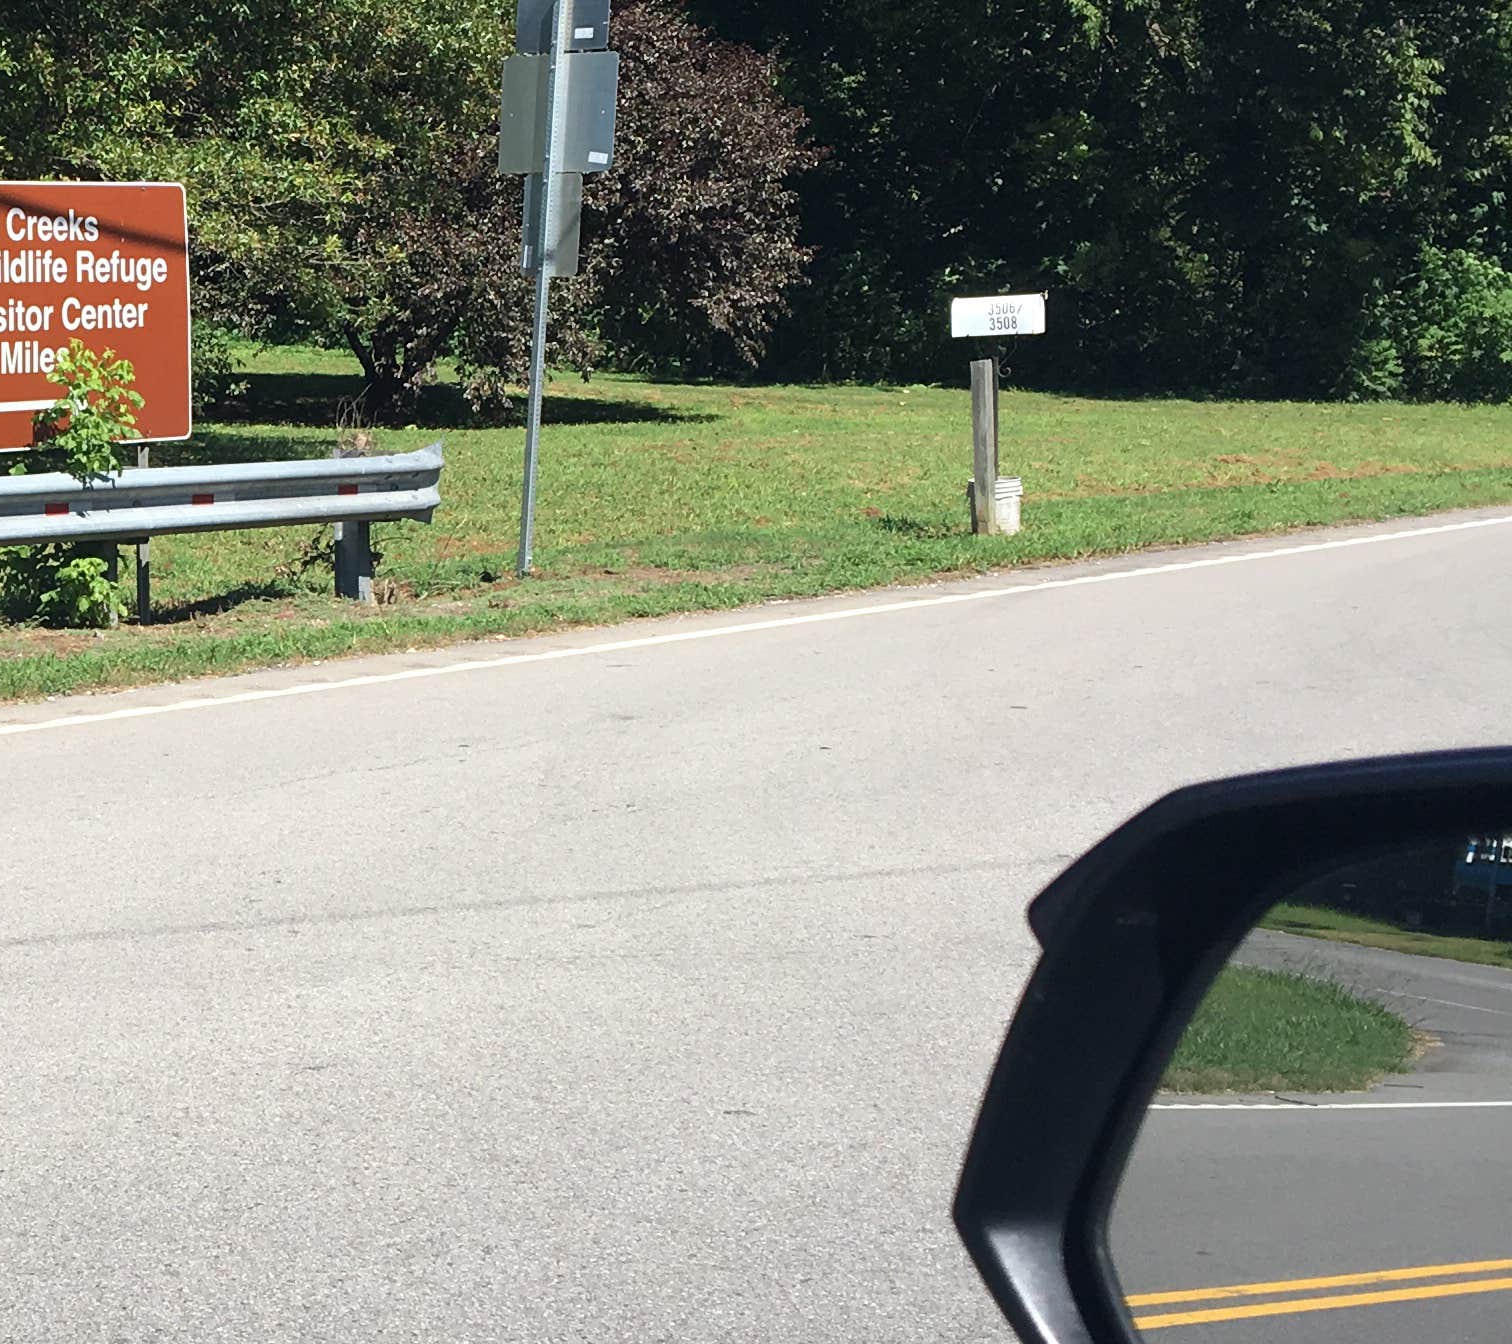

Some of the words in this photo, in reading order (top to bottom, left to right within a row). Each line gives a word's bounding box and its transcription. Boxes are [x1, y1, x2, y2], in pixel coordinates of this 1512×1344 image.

[6, 207, 99, 243] Creeks
[76, 250, 168, 291] Refuge
[61, 296, 148, 331] Center
[989, 315, 1018, 331] 3508
